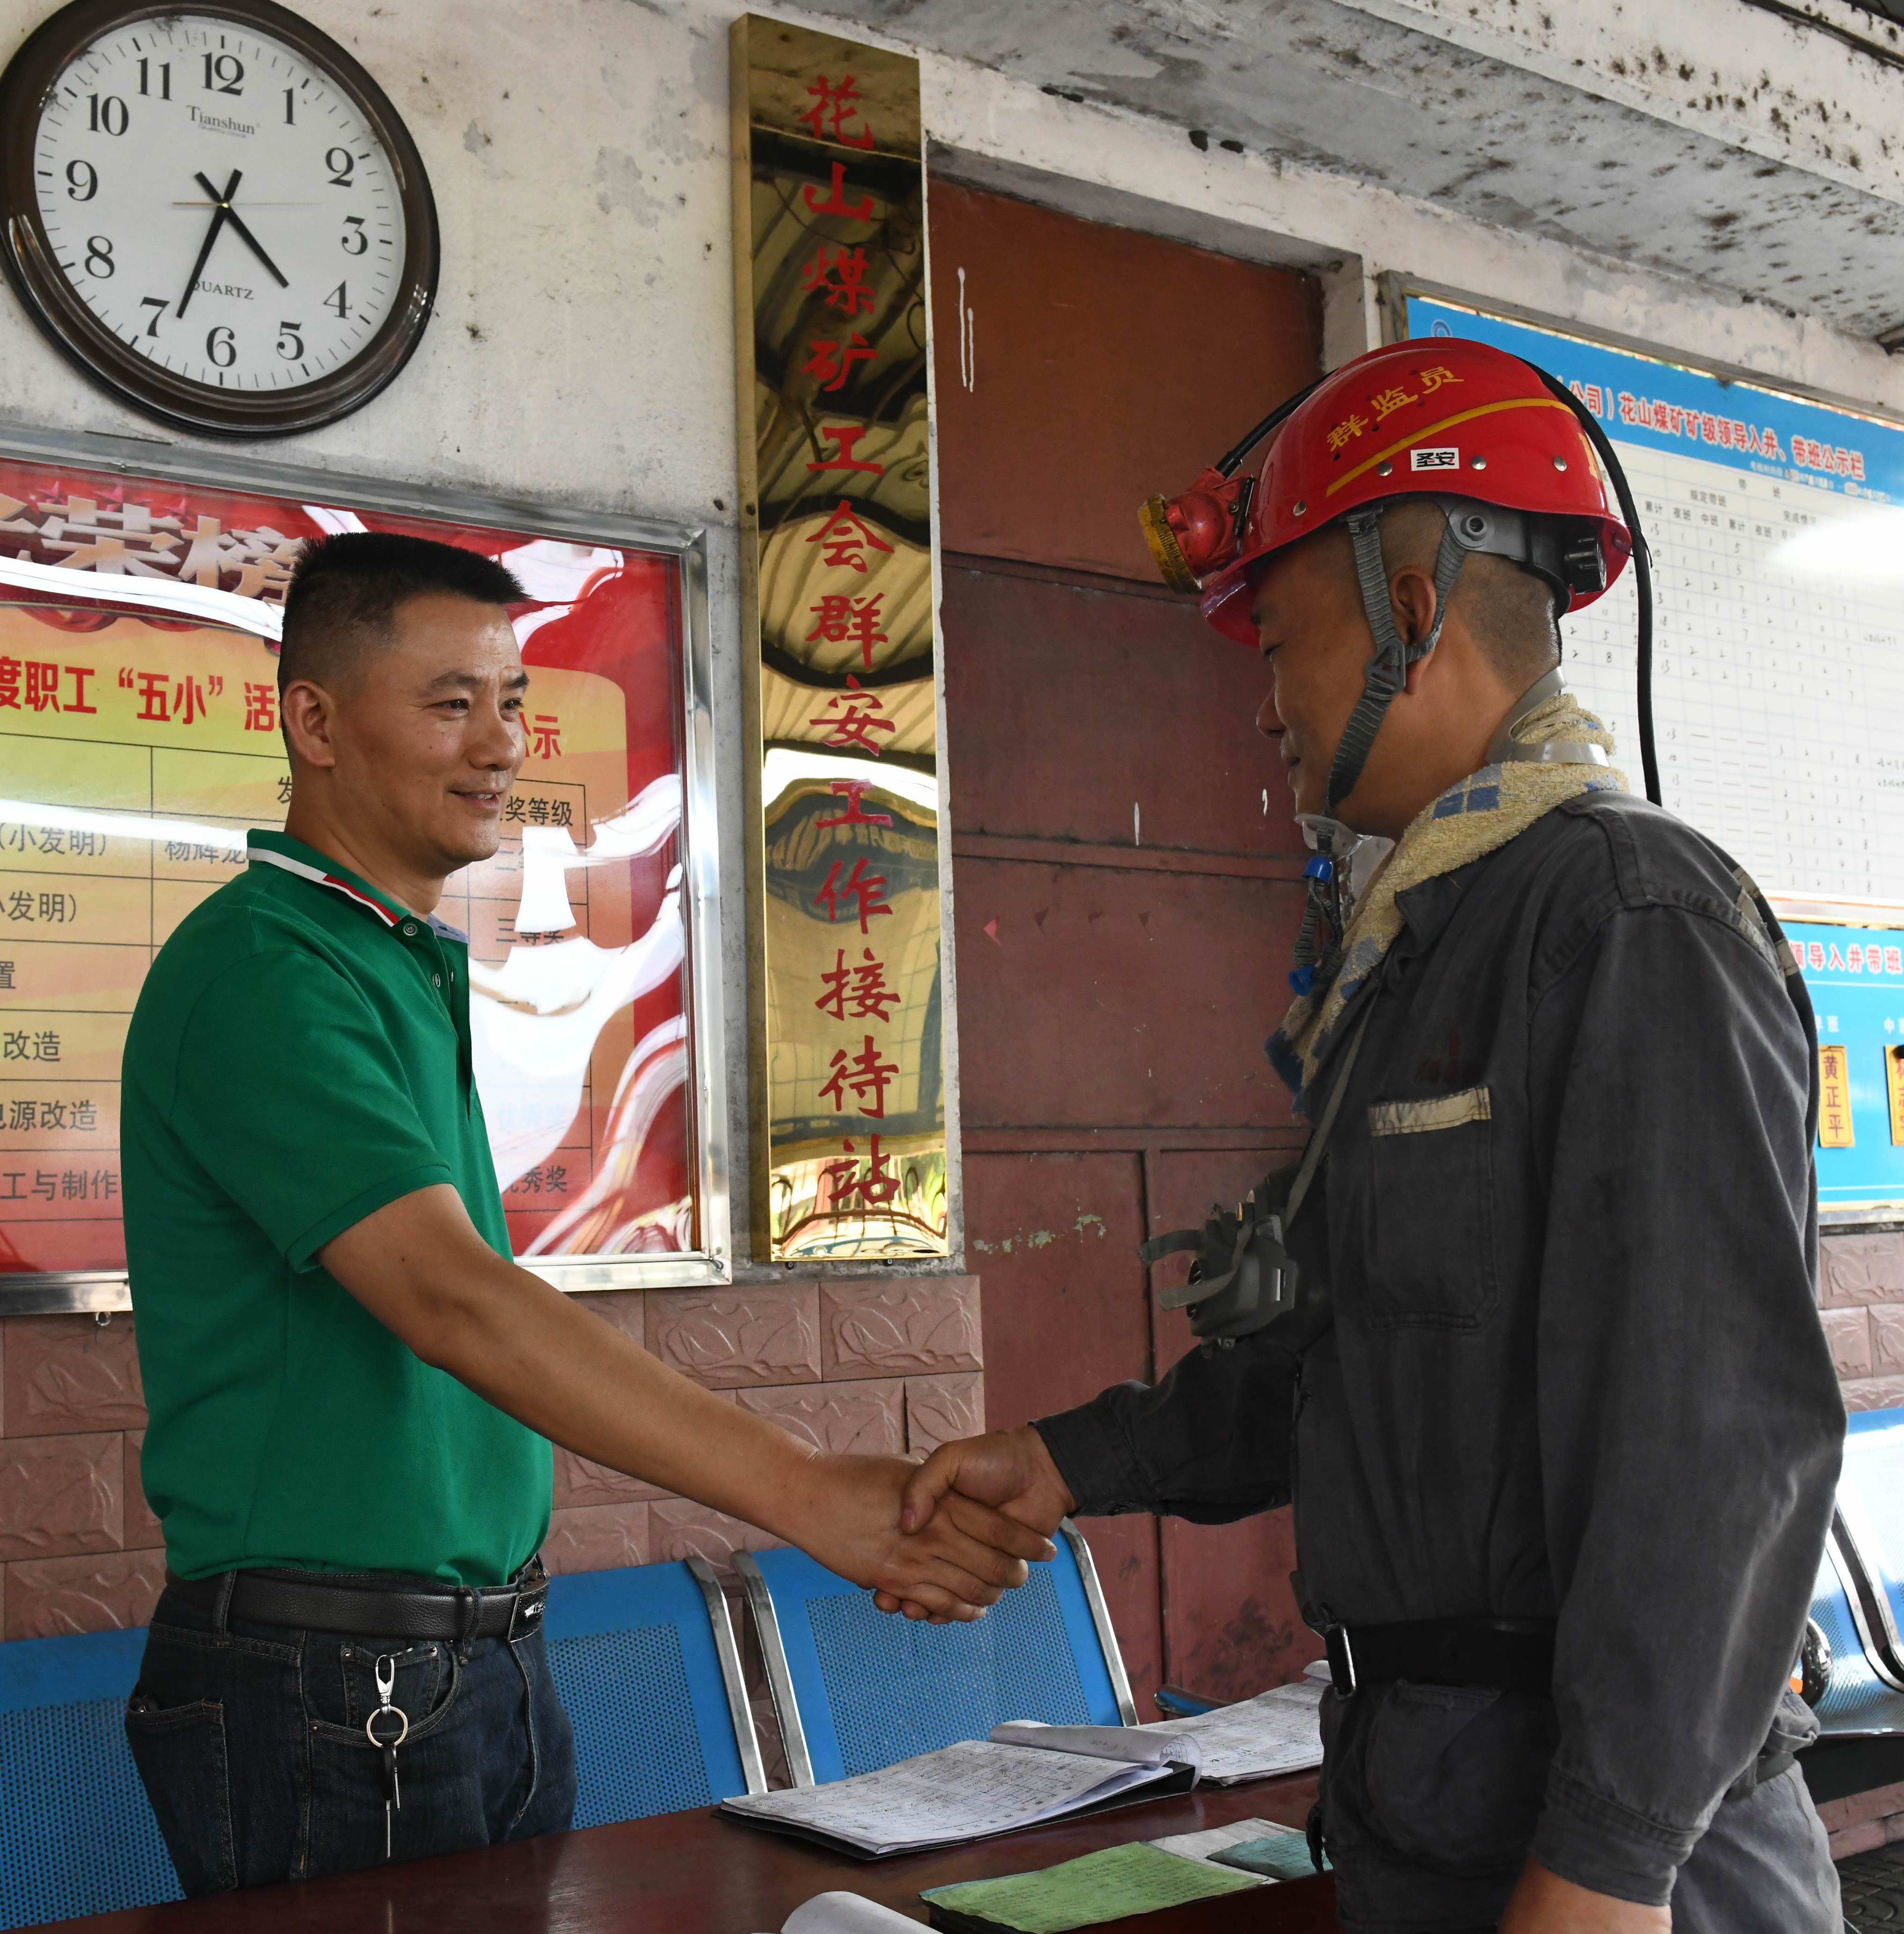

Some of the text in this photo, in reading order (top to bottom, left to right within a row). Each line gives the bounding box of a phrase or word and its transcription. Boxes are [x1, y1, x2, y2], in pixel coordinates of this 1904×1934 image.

[136, 57, 172, 101] 11
[202, 52, 244, 96] 12
[88, 93, 129, 136] 10
[186, 105, 255, 134] Tianshun
[282, 88, 296, 125] 1
[66, 160, 98, 201] 9
[326, 148, 354, 187] 2
[341, 216, 368, 255] 3
[84, 236, 115, 278] 8
[140, 297, 170, 338] 7
[323, 280, 353, 319] 4
[206, 327, 237, 367] 6
[276, 321, 304, 360] 5
[1327, 366, 1464, 452] 群监员
[798, 74, 901, 1205] 花山煤矿工会群安工作接待站
[1606, 652, 1612, 663] 8
[0, 657, 283, 732] 度职工“五小”活
[0, 890, 76, 923] 发明）
[3, 1030, 61, 1062] 改造
[0, 1099, 97, 1131] 源改造
[1823, 1054, 1844, 1139] 黄正平
[0, 1169, 119, 1201] 工与制作
